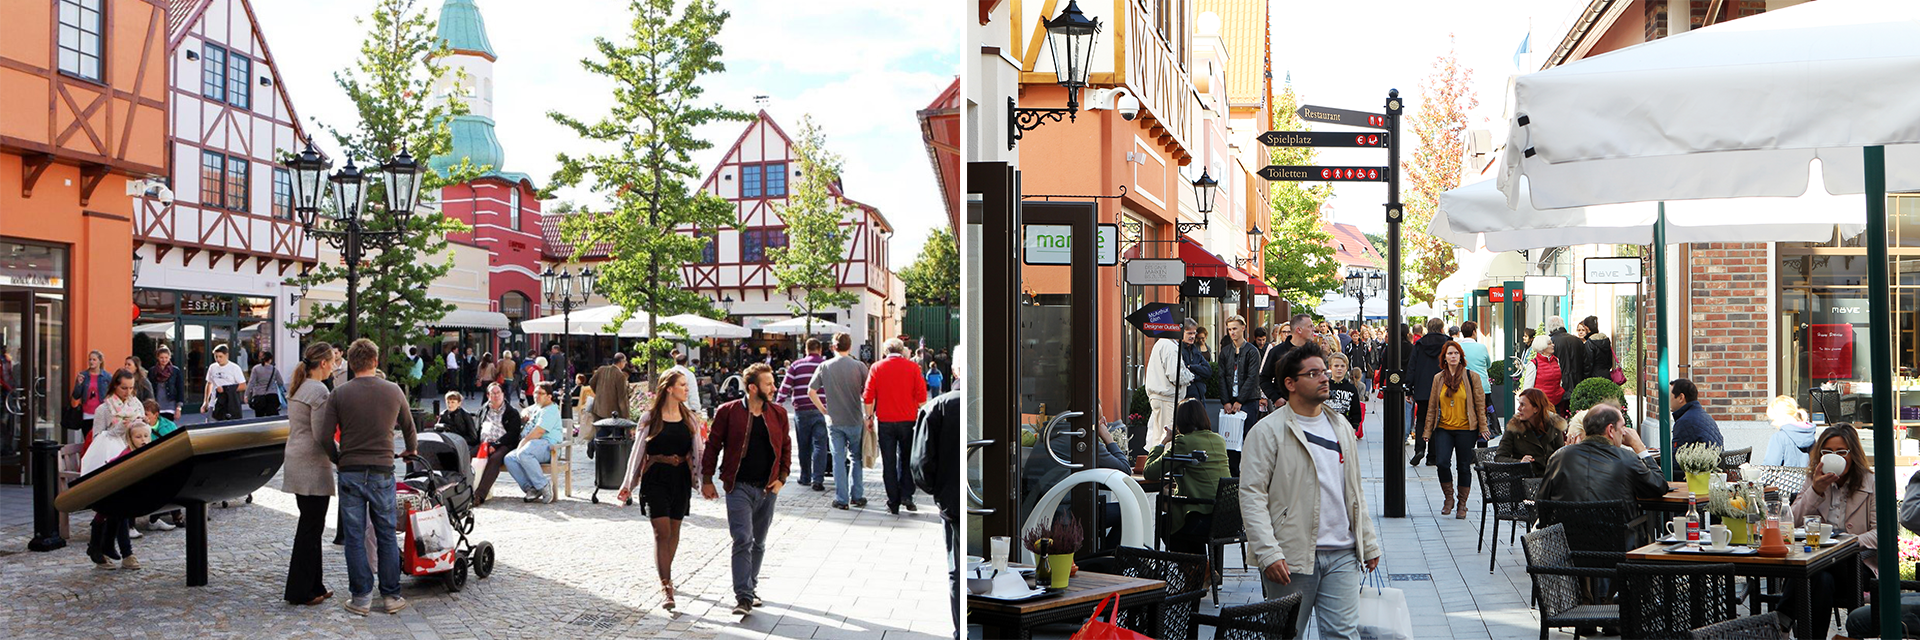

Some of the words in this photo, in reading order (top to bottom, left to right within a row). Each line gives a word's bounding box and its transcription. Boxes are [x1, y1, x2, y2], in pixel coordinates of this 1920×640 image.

[1304, 107, 1341, 122] Restaurant
[1267, 134, 1312, 146] Spielplatz
[1266, 168, 1308, 178] Toiletten
[1036, 230, 1105, 249] maré
[187, 300, 226, 311] ESPRIT
[1144, 323, 1164, 331] Designer
